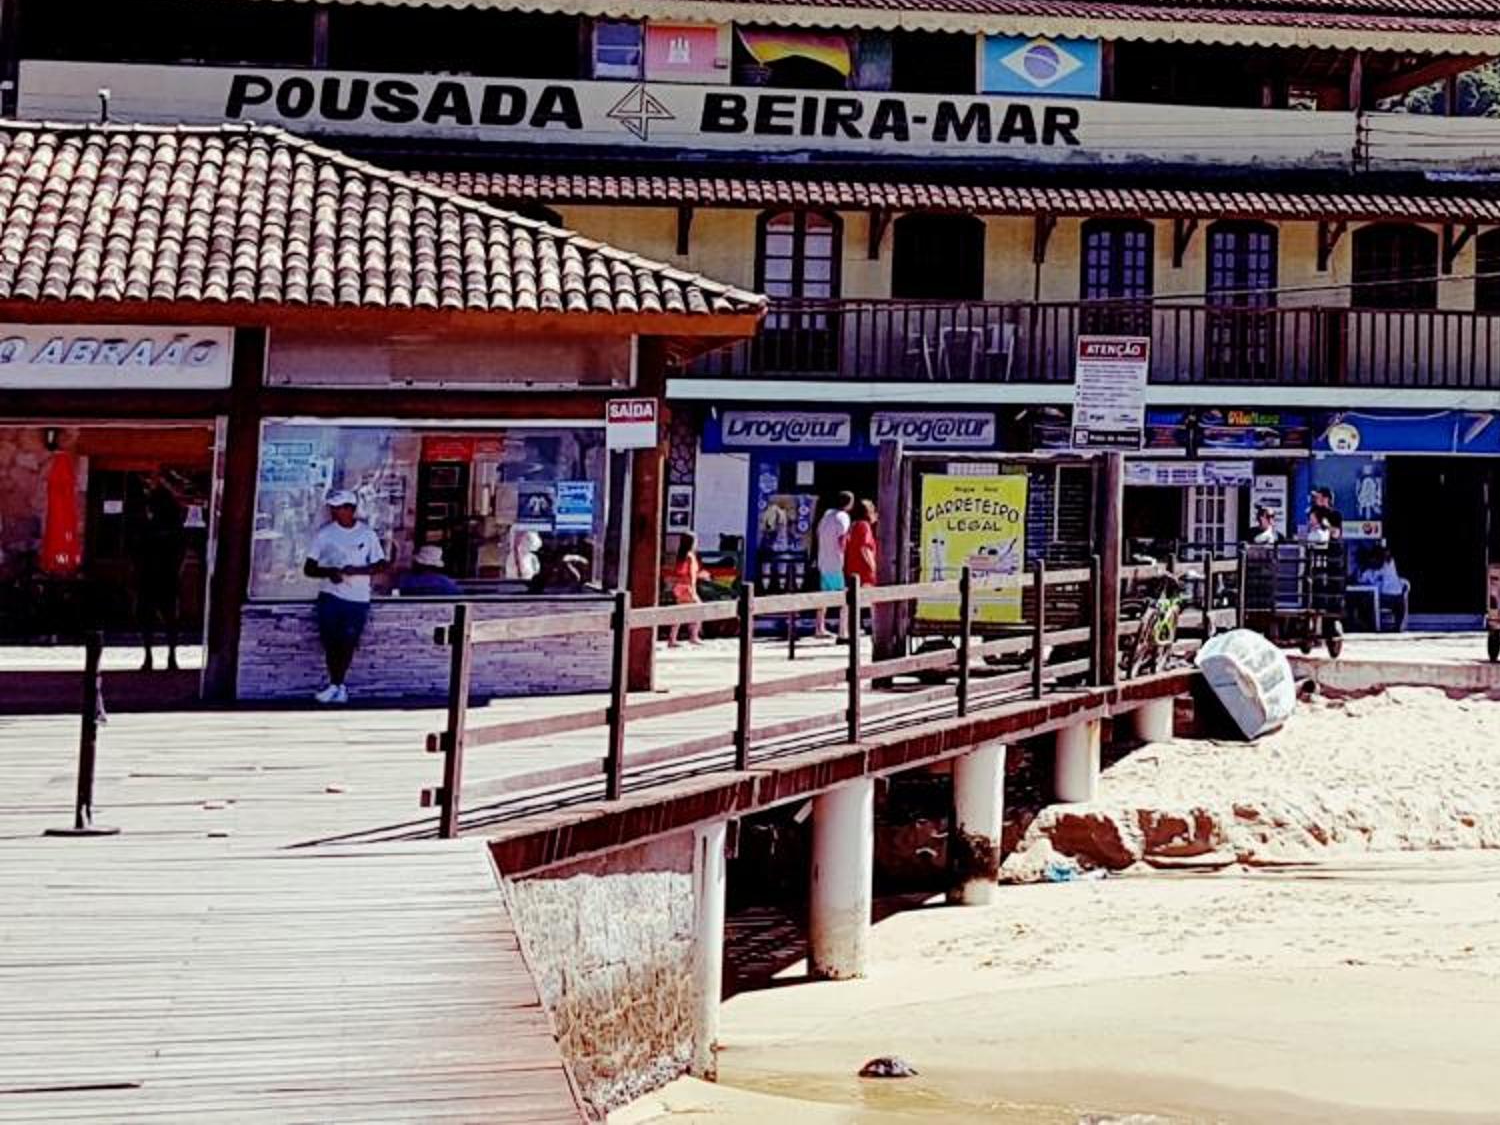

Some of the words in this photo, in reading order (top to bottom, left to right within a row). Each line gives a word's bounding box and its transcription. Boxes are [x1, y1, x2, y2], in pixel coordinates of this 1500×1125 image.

[225, 74, 583, 130] POUSADA
[699, 92, 1082, 147] BEIRA-MAR
[30, 333, 218, 366] ABRAÃO
[1086, 341, 1142, 356] ATENÇÃO
[609, 402, 654, 418] SAÍDA
[727, 417, 847, 442] Drog@tur
[875, 417, 991, 442] Drog@tur
[925, 497, 1019, 524] CARRETEIRO
[947, 519, 1002, 532] LEGAL
